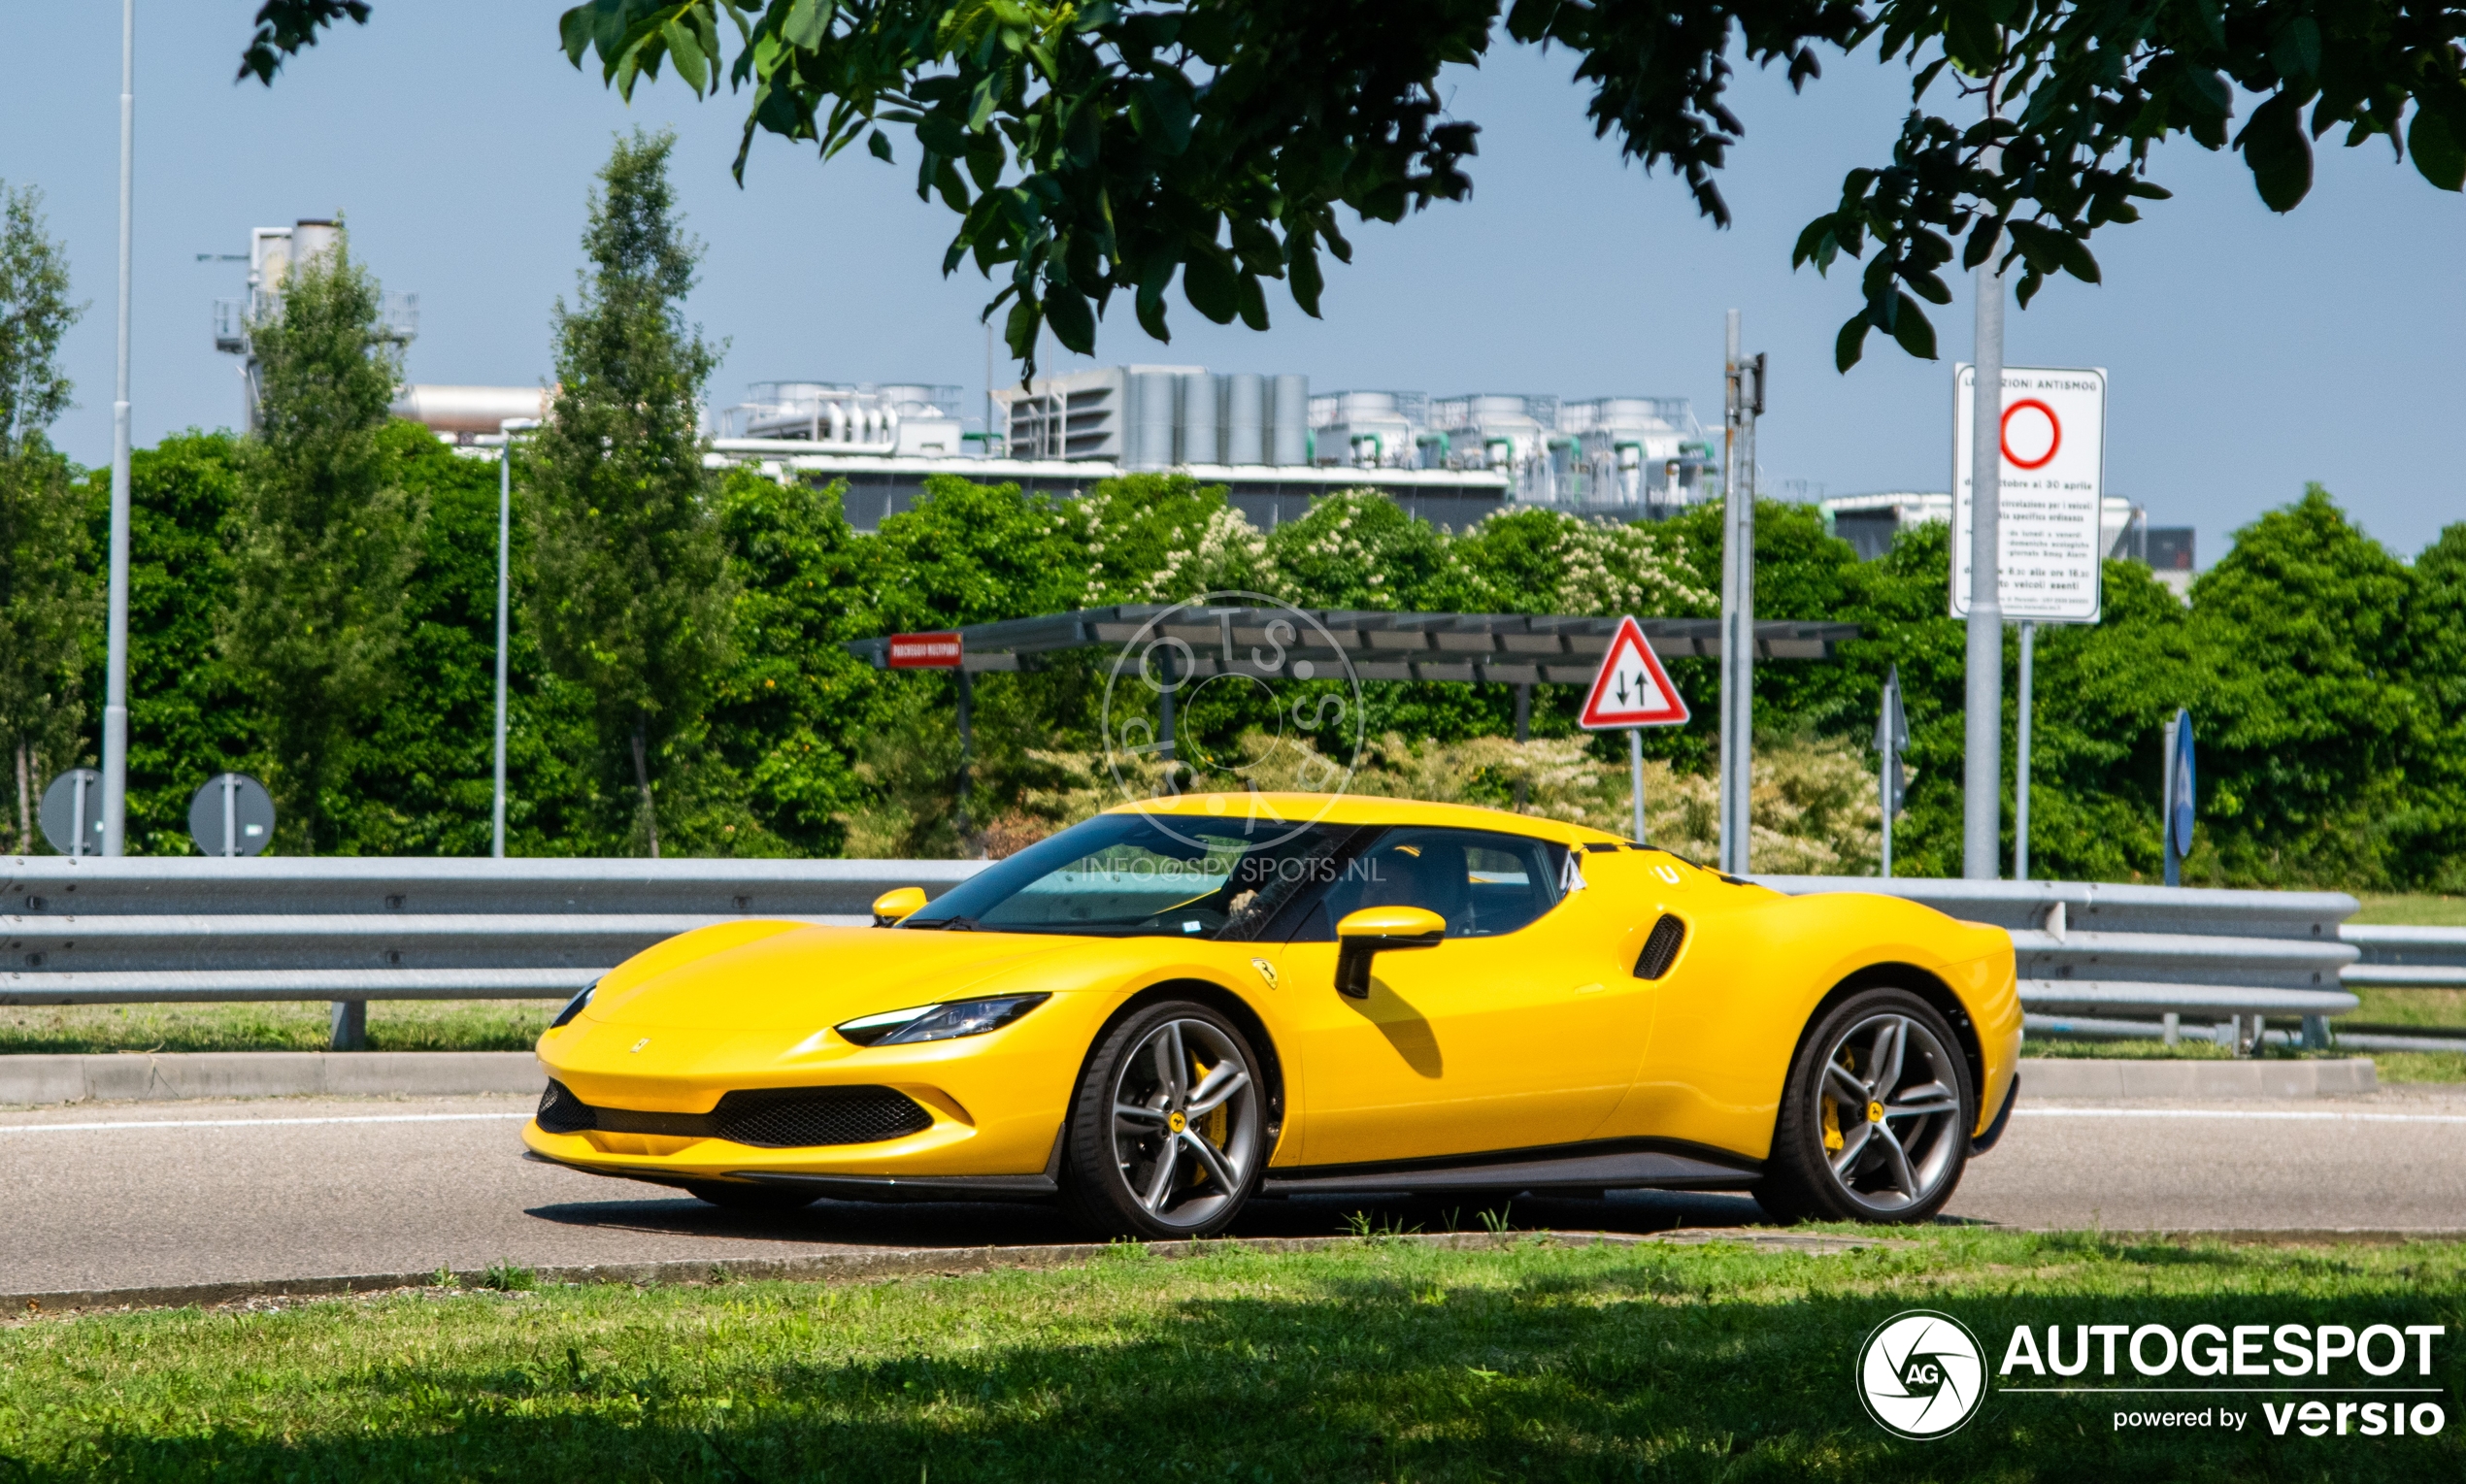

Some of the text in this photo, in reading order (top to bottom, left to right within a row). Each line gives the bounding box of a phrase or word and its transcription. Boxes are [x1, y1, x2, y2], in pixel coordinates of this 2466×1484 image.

[2038, 379, 2097, 391] ANTISMOG
[2064, 480, 2092, 491] aprile
[2015, 579, 2047, 589] veicoli
[2050, 581, 2081, 591] esenti
